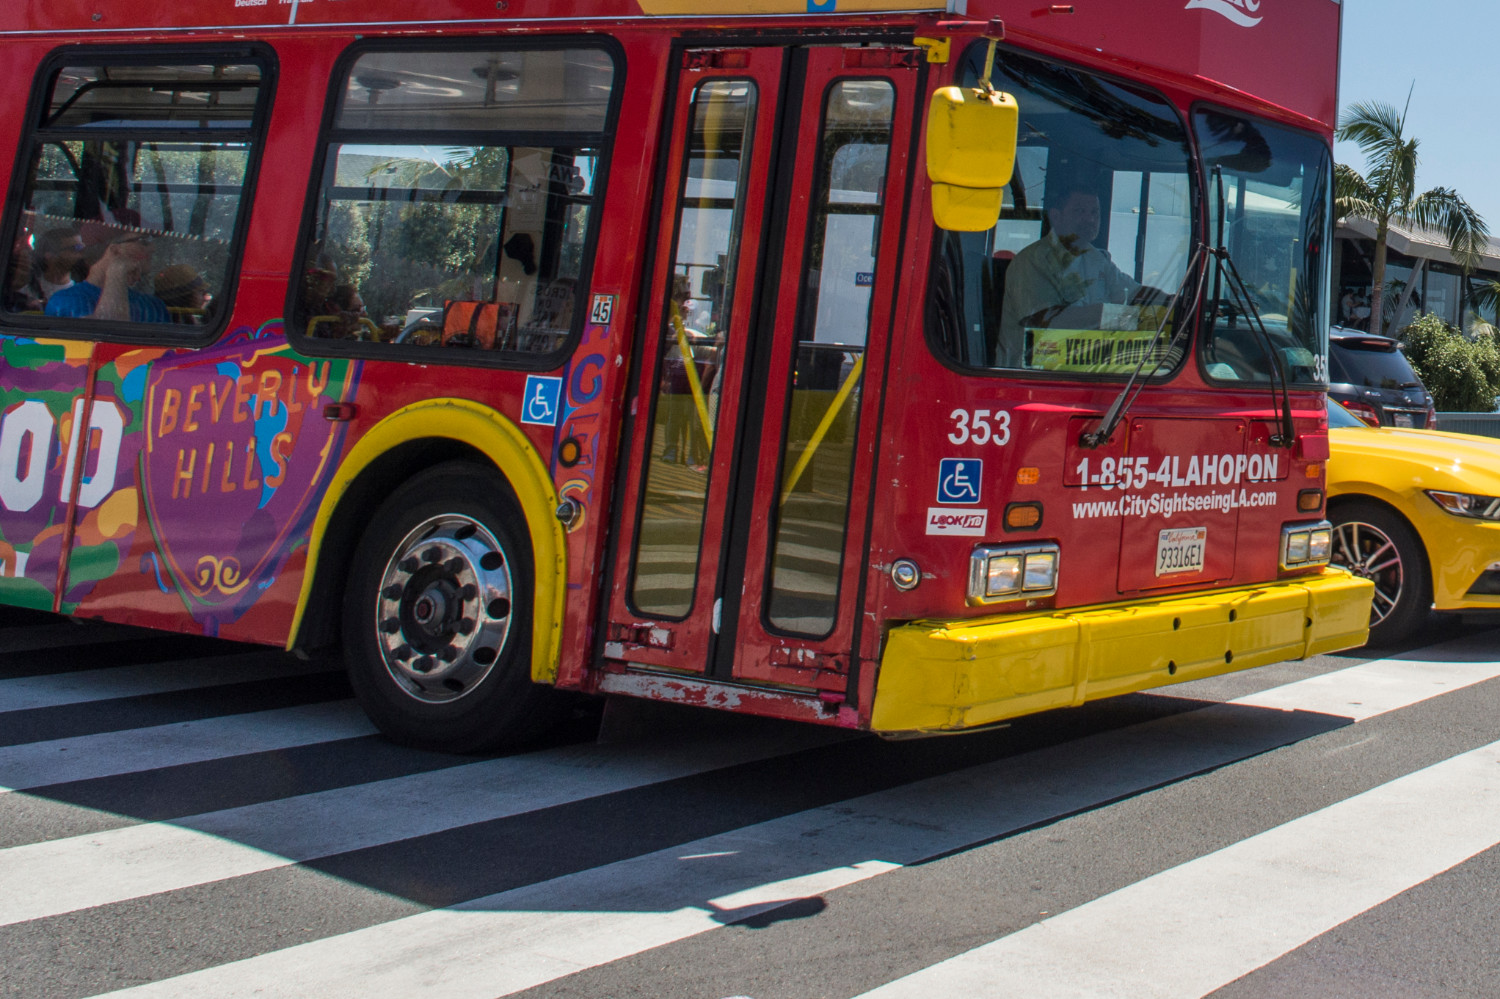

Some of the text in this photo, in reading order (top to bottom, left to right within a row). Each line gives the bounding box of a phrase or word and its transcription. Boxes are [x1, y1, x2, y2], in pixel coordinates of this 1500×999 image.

[857, 273, 872, 283] Oce
[592, 302, 610, 322] 45
[1066, 338, 1114, 365] YELLOW
[1313, 353, 1328, 383] 35
[158, 361, 331, 438] BEVERLY
[948, 408, 1011, 446] 353
[172, 432, 293, 499] HILLS
[1077, 454, 1279, 491] 1-855-4LAHOPON
[1072, 489, 1277, 519] www.CitySightseeingLA.com
[1168, 531, 1196, 545] California
[1160, 544, 1201, 570] 93316E1
